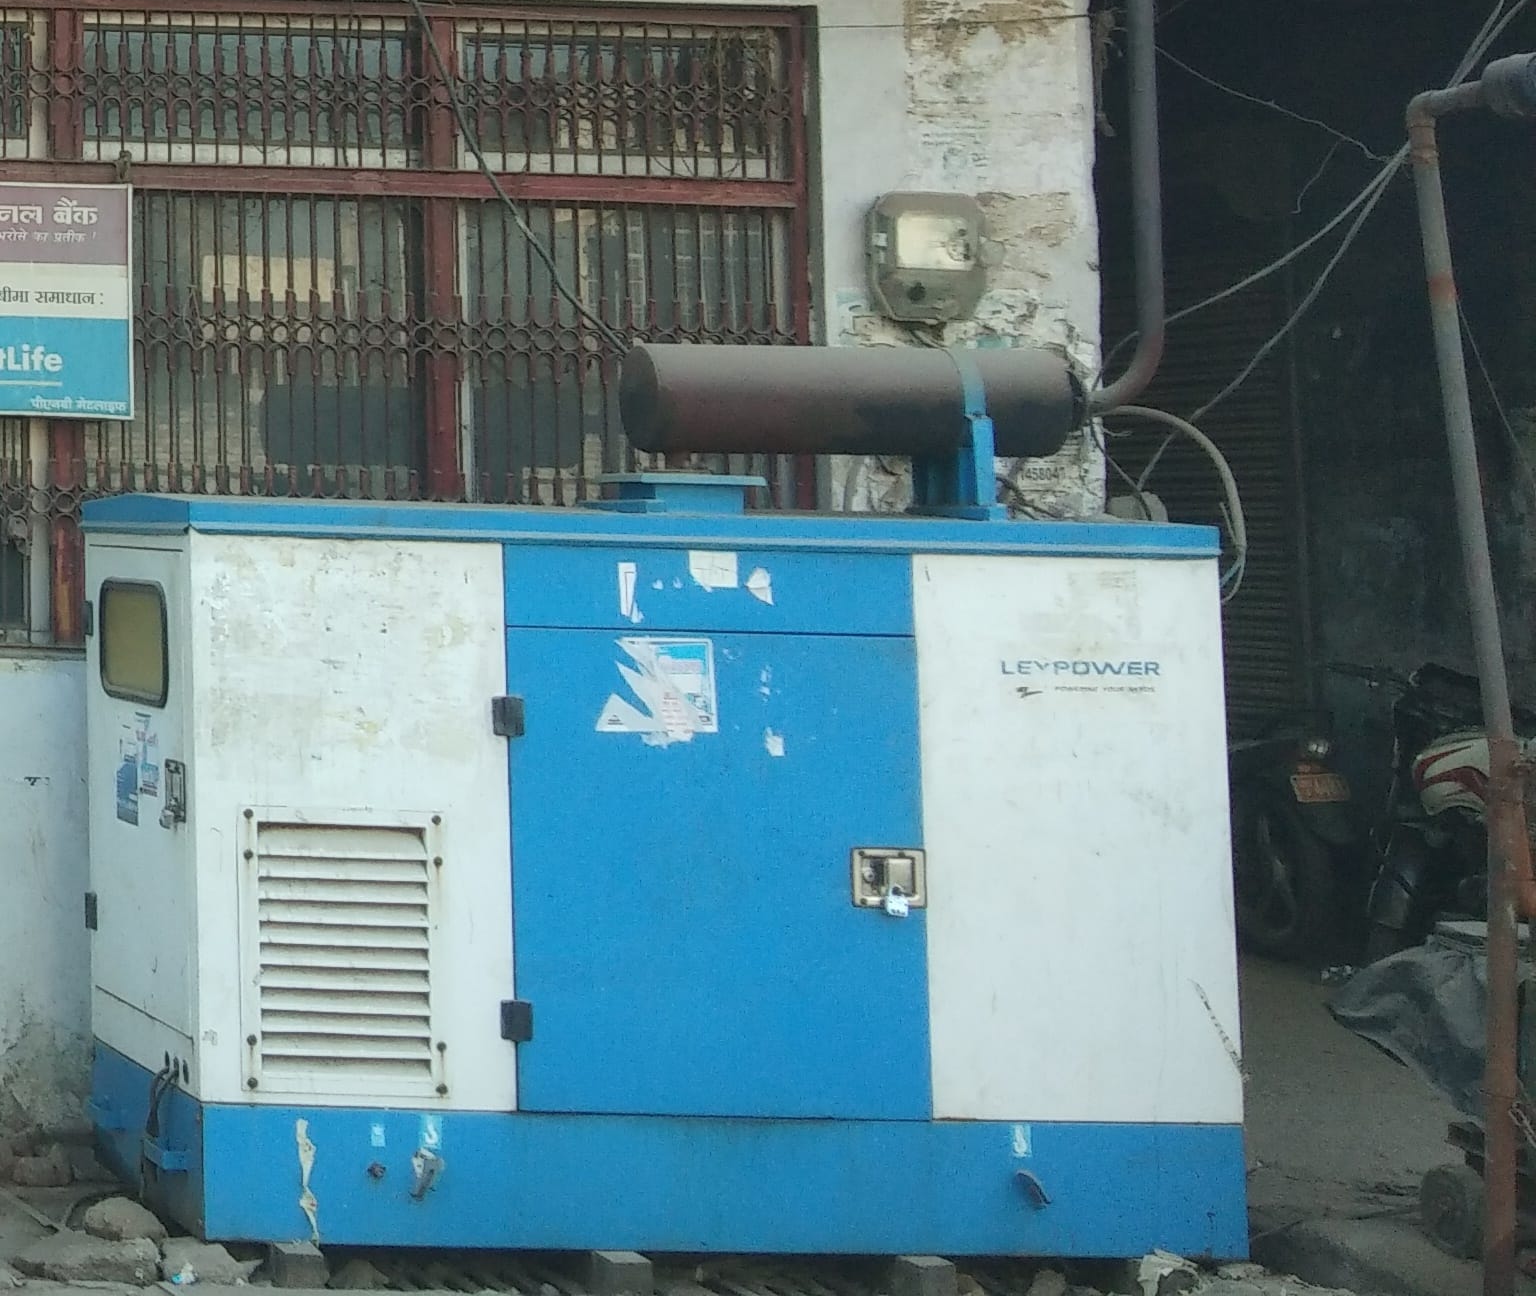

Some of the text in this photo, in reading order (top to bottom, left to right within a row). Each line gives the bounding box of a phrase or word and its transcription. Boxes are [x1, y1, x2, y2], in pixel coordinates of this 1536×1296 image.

[52, 196, 98, 226] बैंक
[34, 289, 96, 306] समाधान
[1000, 660, 1160, 676] LEYPOWER
